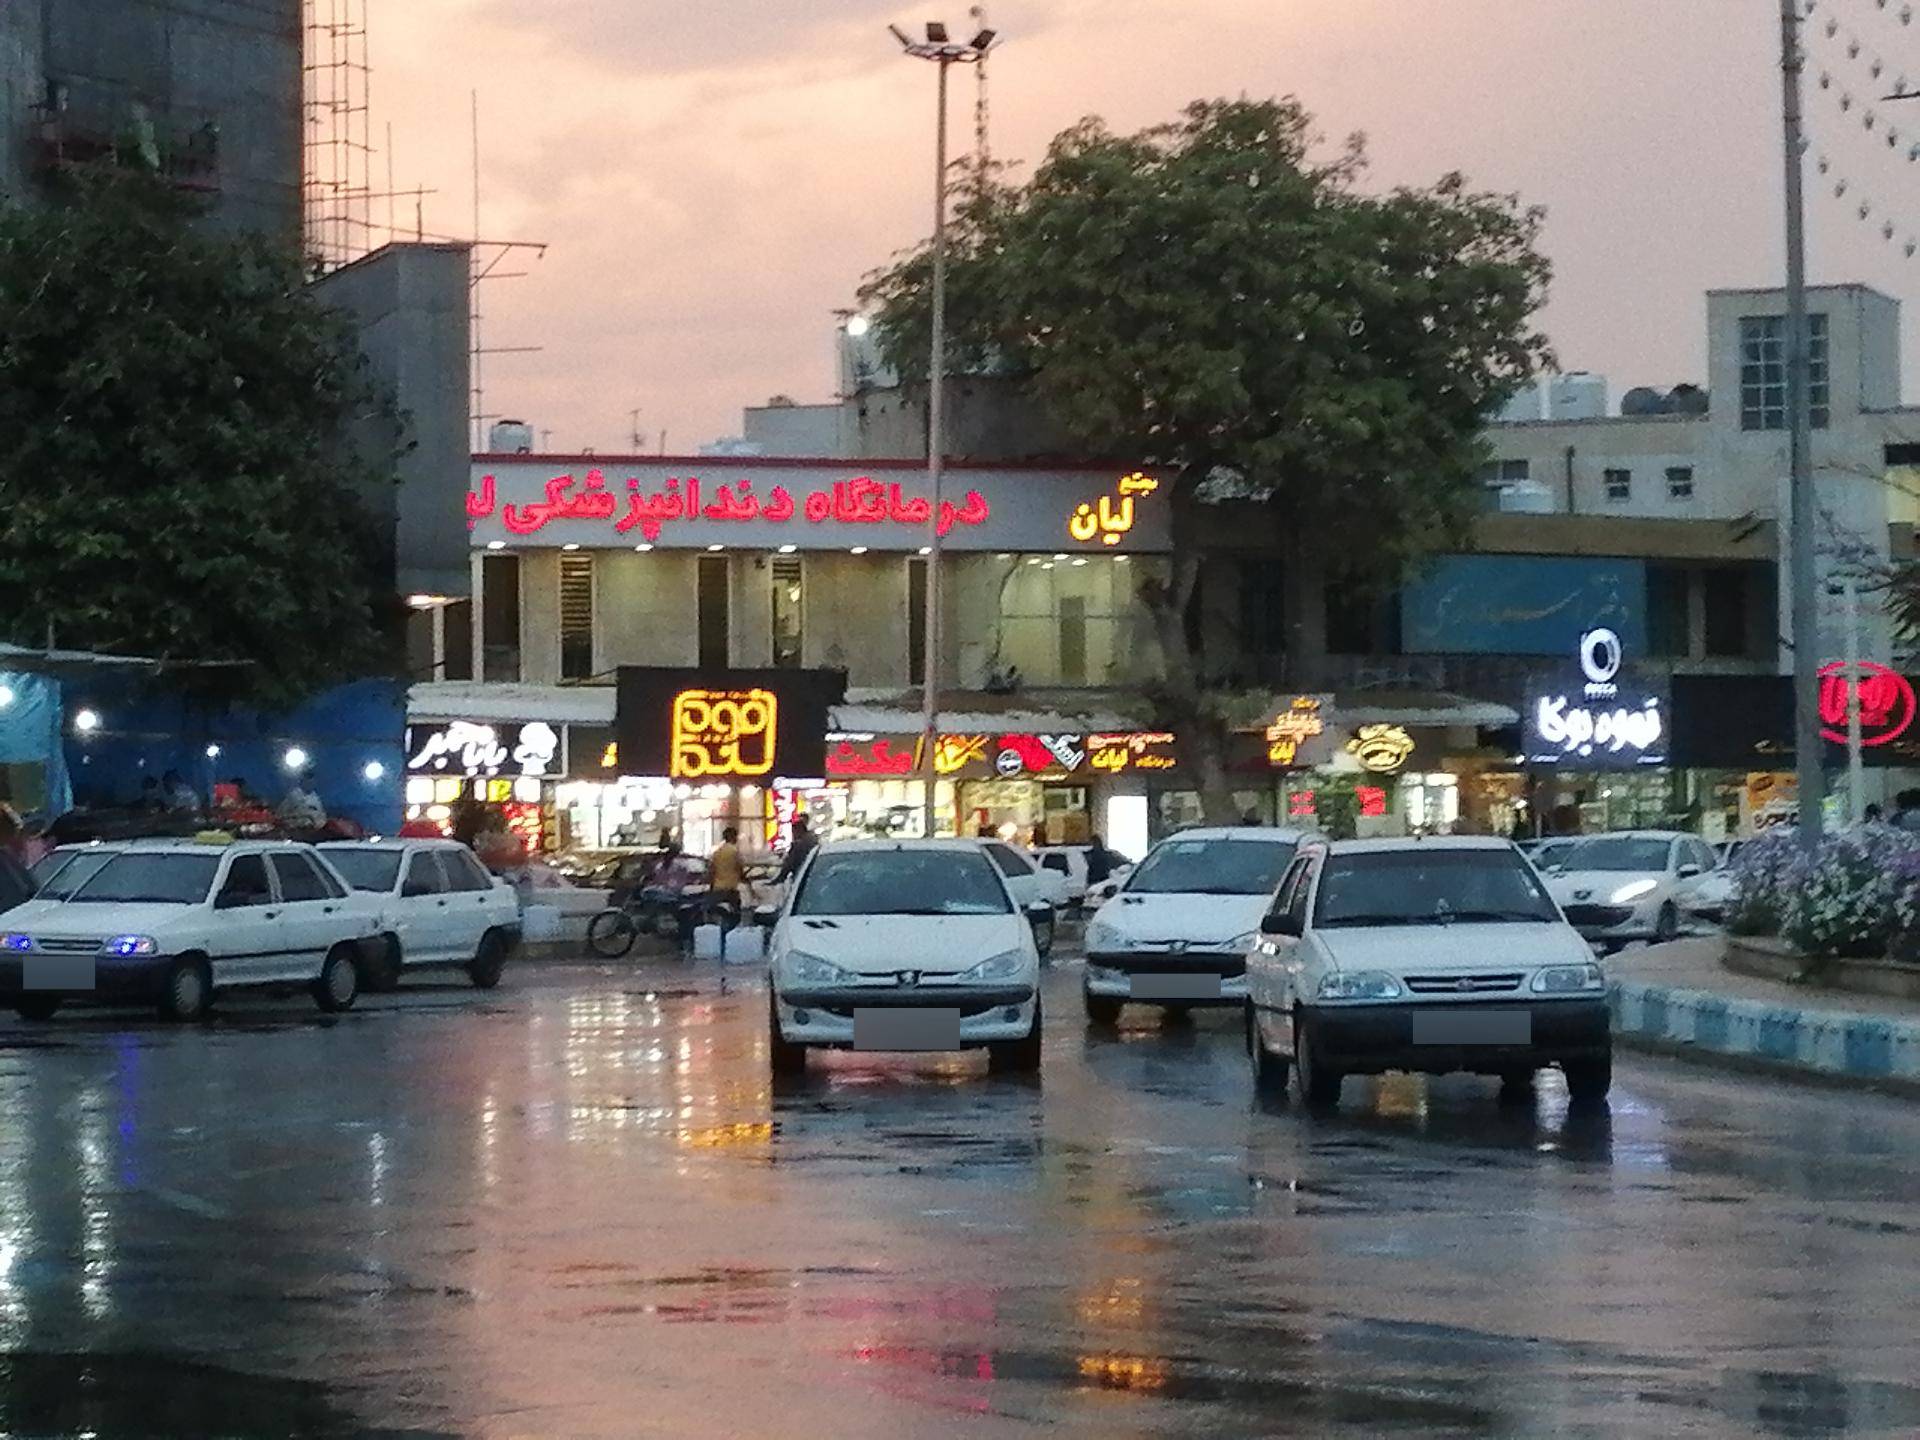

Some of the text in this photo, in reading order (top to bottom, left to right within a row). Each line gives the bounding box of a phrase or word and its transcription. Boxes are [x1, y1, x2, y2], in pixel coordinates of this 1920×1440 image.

[503, 468, 795, 541] دندانپزشکی
[804, 476, 990, 537] درمانگاه
[1069, 493, 1134, 545] لیان
